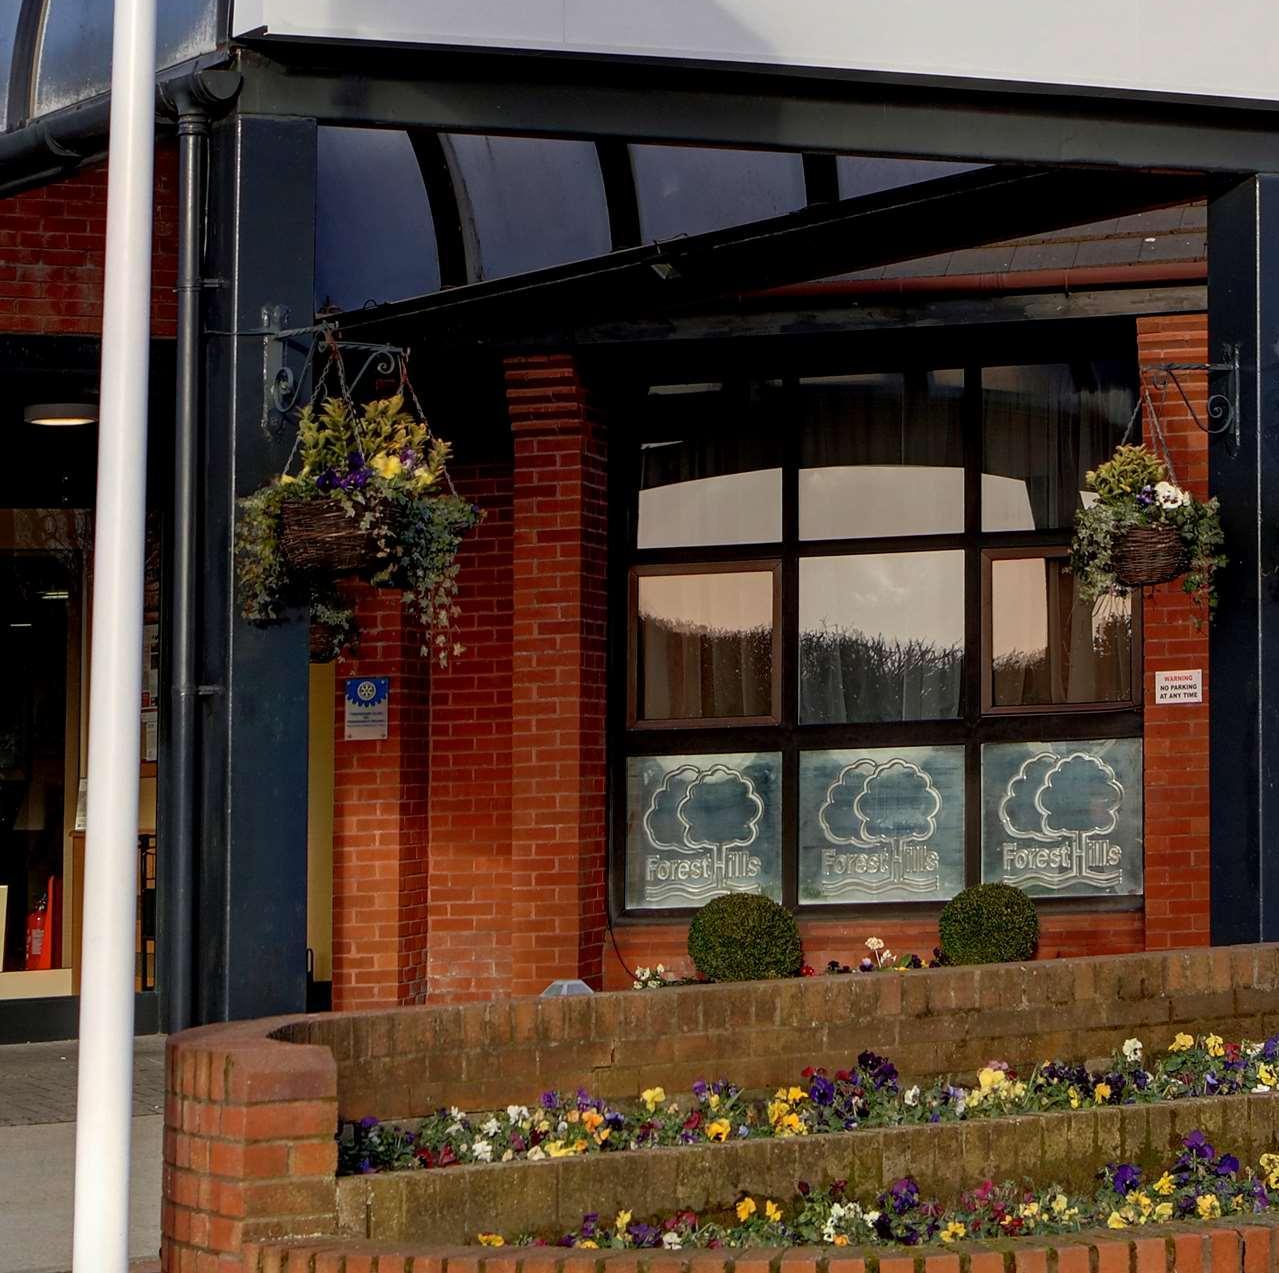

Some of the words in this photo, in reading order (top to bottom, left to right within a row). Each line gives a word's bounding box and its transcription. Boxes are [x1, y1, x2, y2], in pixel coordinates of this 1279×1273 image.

[646, 854, 711, 882] Forest
[821, 847, 889, 876] Forest
[1002, 841, 1070, 871] Forest
[1072, 839, 1123, 873] Hills
